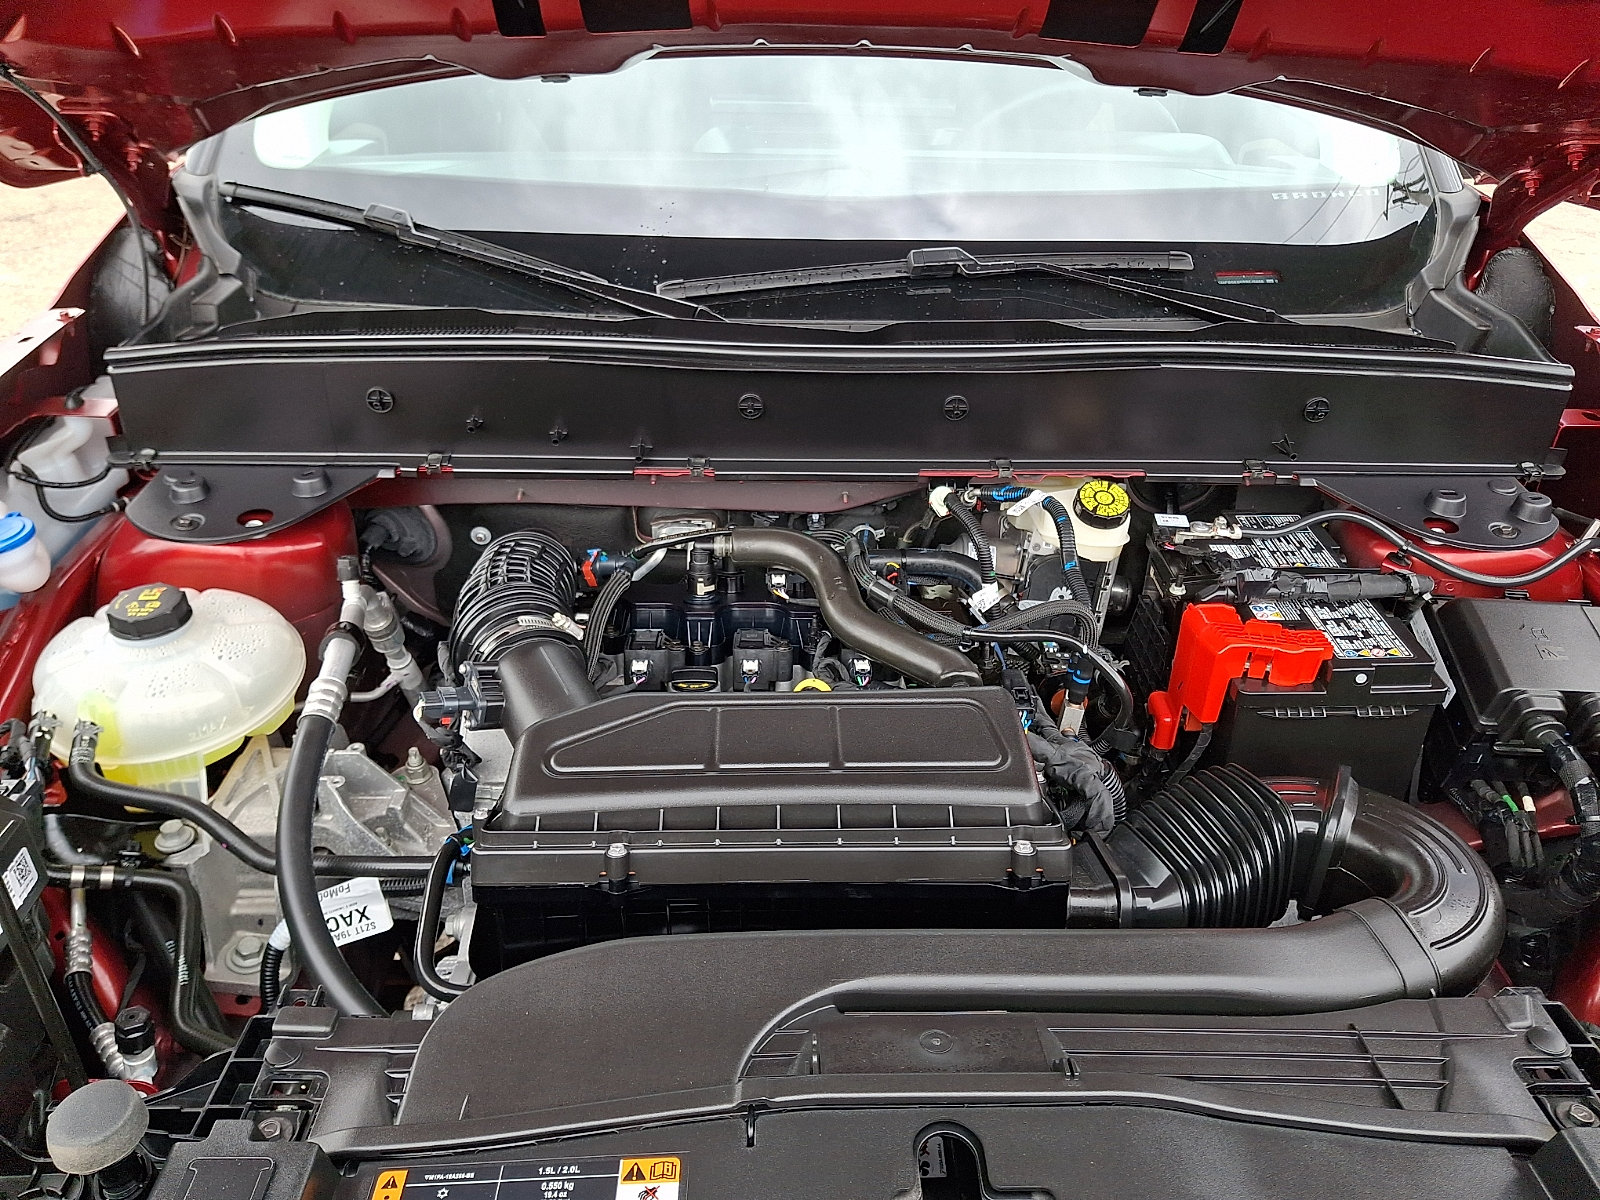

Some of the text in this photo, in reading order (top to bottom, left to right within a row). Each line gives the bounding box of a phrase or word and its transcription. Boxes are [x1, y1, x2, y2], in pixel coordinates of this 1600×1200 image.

[326, 905, 371, 933] XAC
[561, 1165, 581, 1174] 2.0L
[563, 1181, 575, 1191] kg
